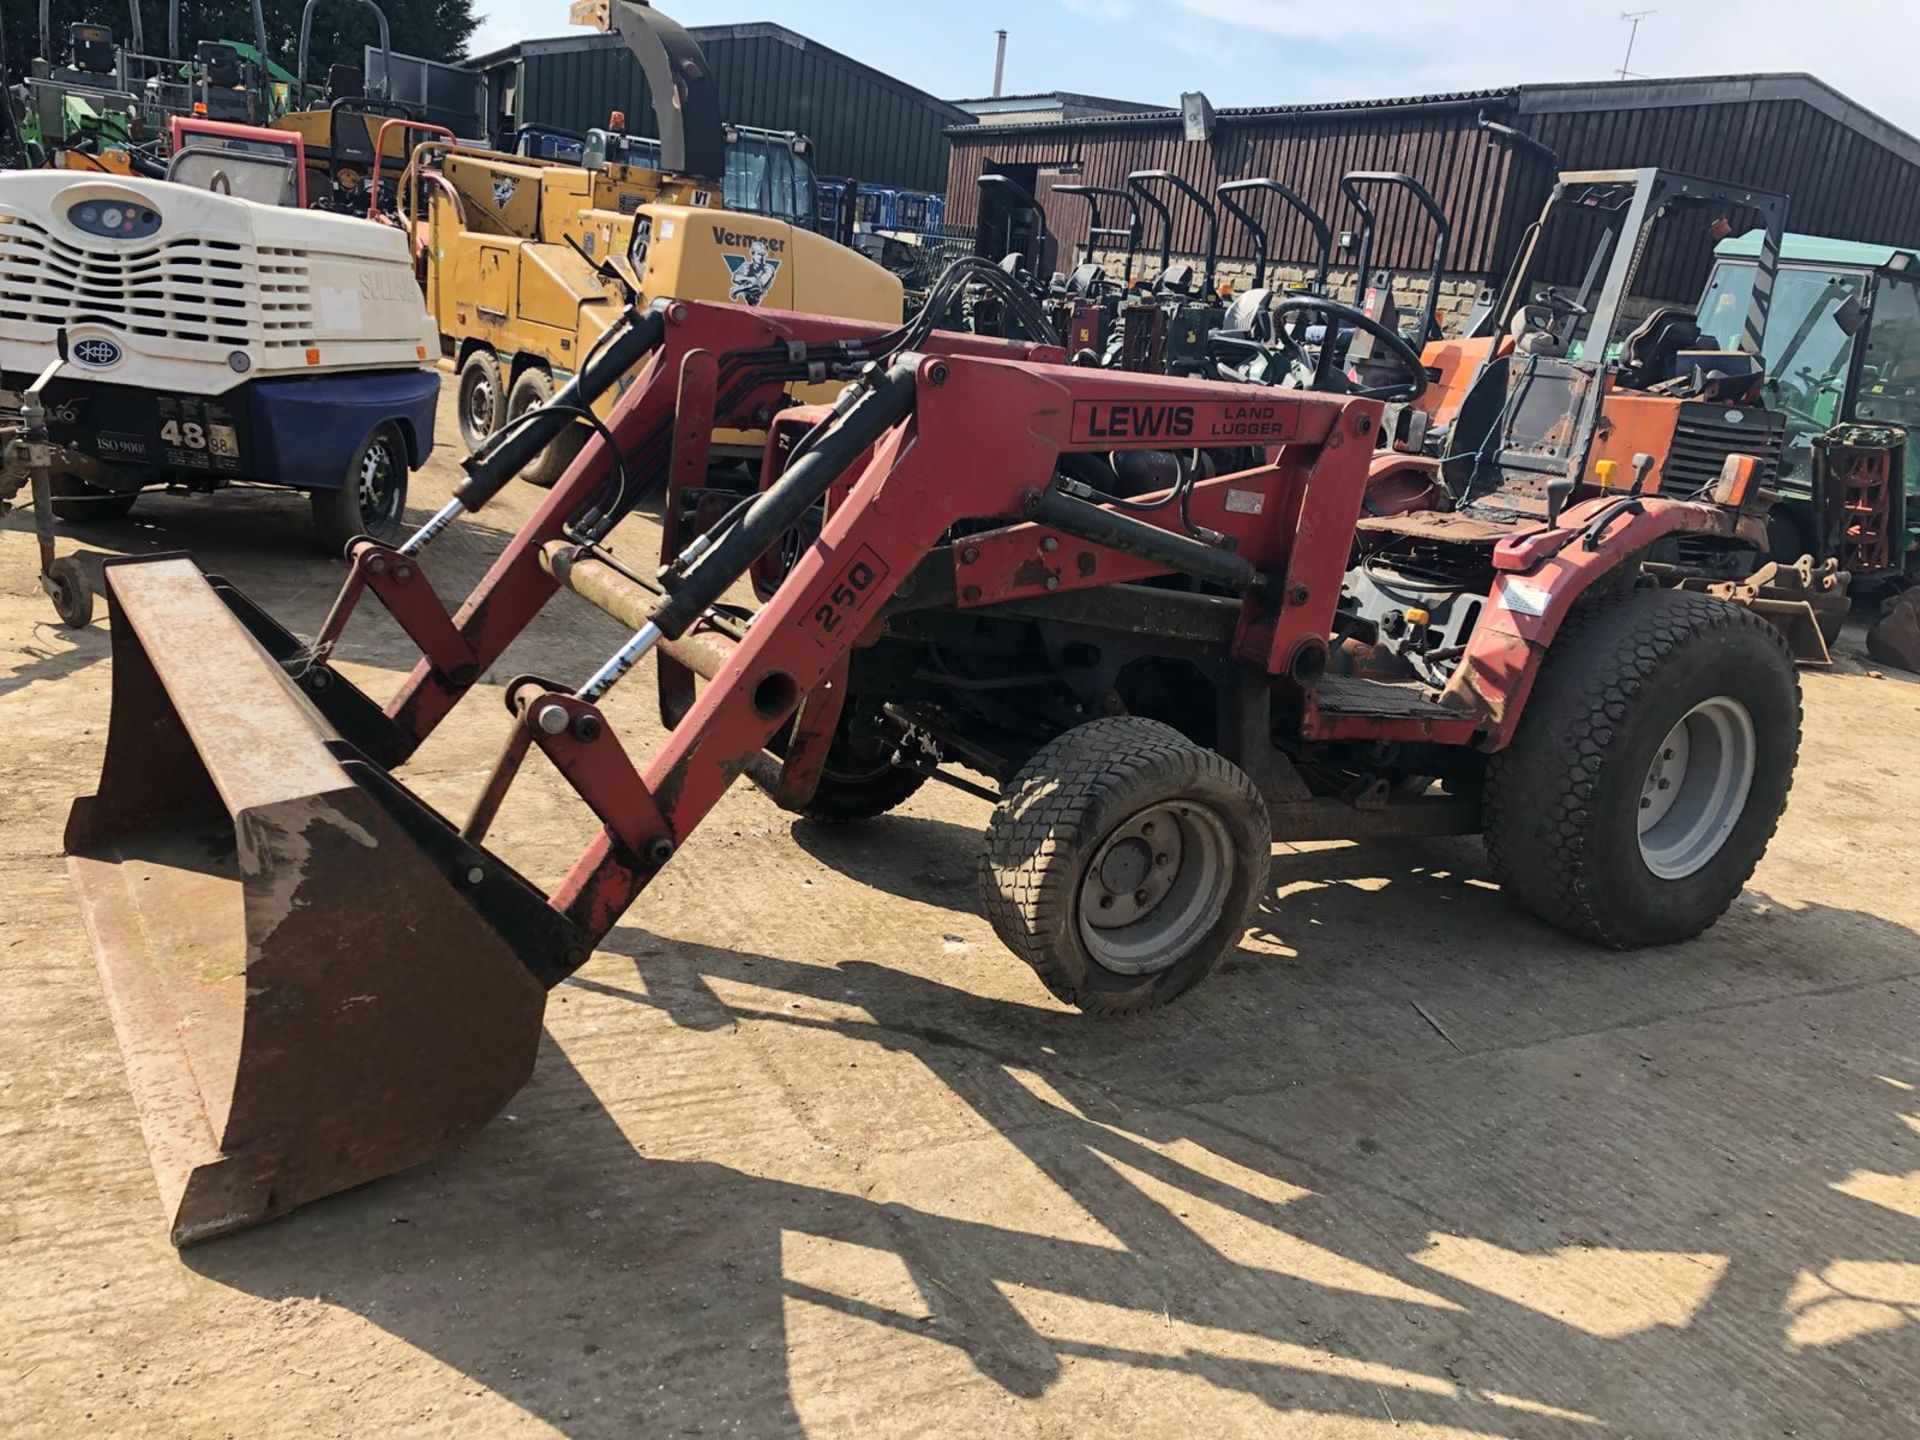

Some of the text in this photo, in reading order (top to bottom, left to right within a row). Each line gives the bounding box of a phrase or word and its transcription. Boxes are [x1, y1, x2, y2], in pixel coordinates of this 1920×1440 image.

[712, 226, 785, 252] Vermeer
[1089, 406, 1194, 437] LEWIS
[1224, 407, 1275, 419] LAND
[160, 419, 206, 449] 48
[1211, 423, 1283, 436] LUGGER
[96, 437, 119, 451] ISO
[815, 562, 877, 633] 250
